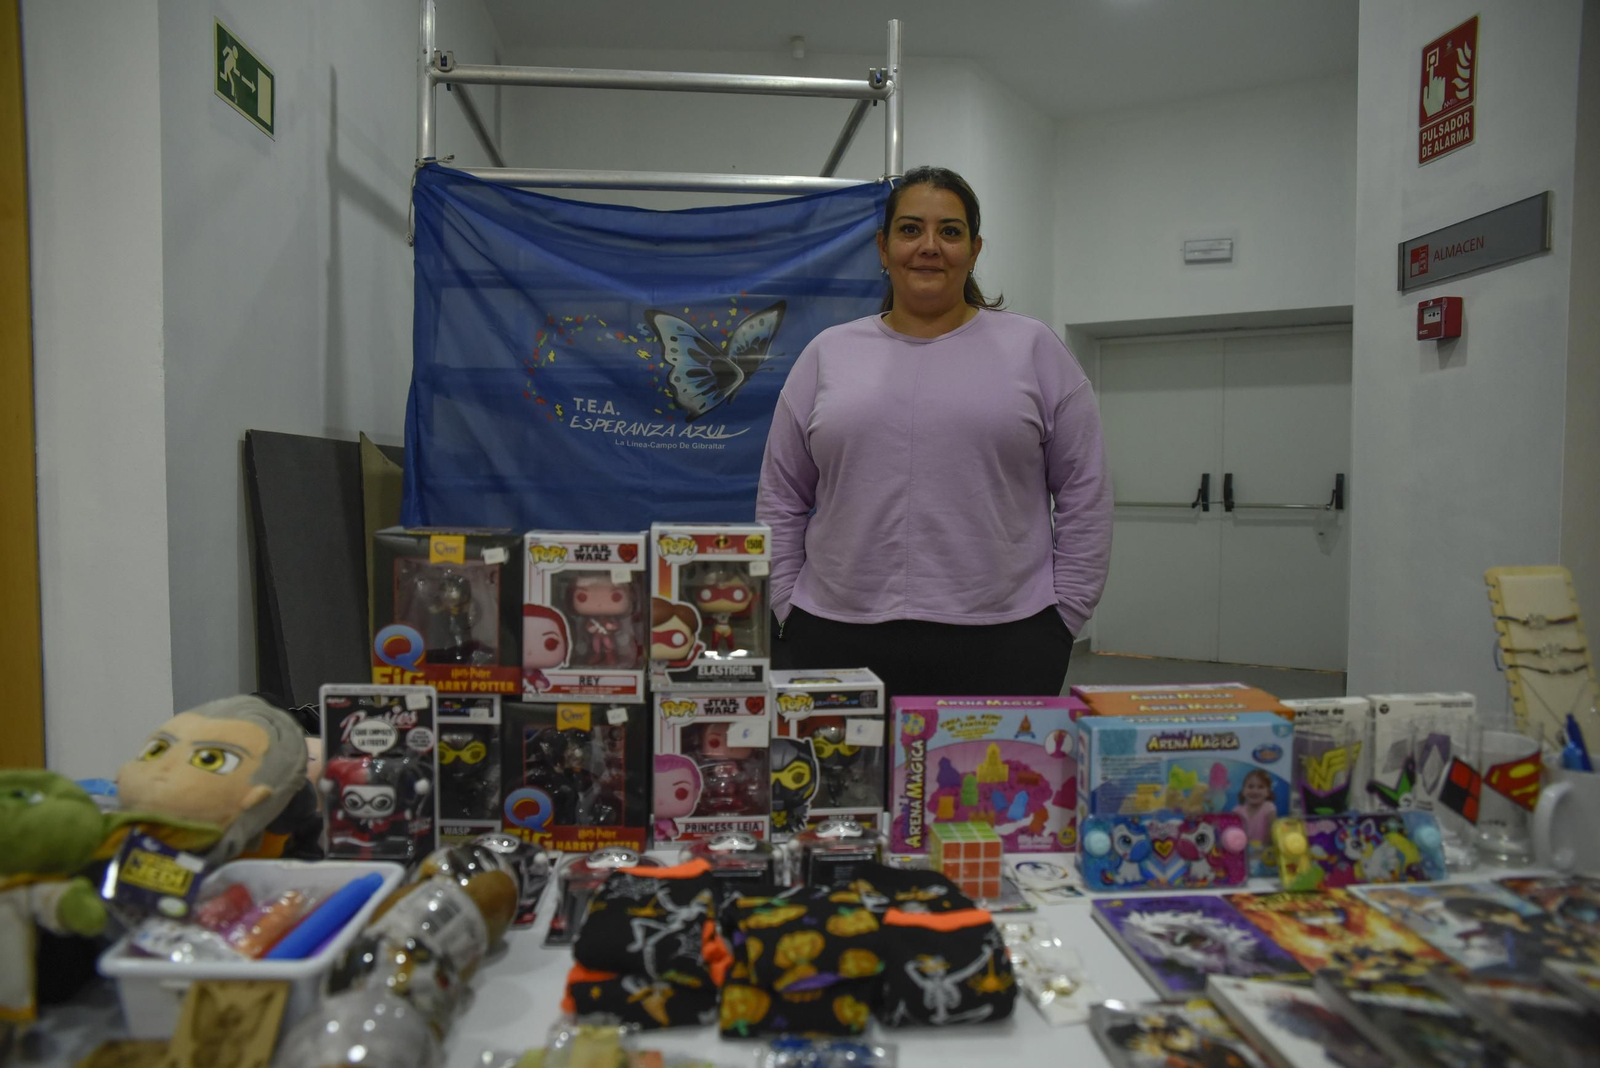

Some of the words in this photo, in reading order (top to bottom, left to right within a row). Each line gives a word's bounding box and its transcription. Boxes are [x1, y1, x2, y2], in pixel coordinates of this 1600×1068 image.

[1422, 111, 1470, 144] PULSADOR
[1422, 143, 1433, 158] DE
[1433, 126, 1470, 154] ALARMA
[1433, 236, 1484, 262] ALMACEN
[573, 397, 621, 416] T.E.A.
[570, 415, 676, 438] ESPERANZA
[678, 422, 751, 440] AZUL
[615, 438, 625, 446] La
[692, 442, 726, 450] Gibraltar
[574, 545, 611, 553] STAR
[574, 552, 611, 561] WARS
[697, 665, 756, 676] ELASTIGIRL
[470, 681, 515, 692] POTTER
[579, 676, 600, 686] REY
[704, 698, 739, 707] STAR
[704, 706, 739, 715] WARS
[1149, 737, 1189, 750] ARENA
[685, 823, 733, 832] PRINCESS
[736, 823, 759, 831] LEIA
[904, 799, 923, 849] ARENA
[443, 826, 472, 836] WASP
[555, 840, 595, 850] HARRY
